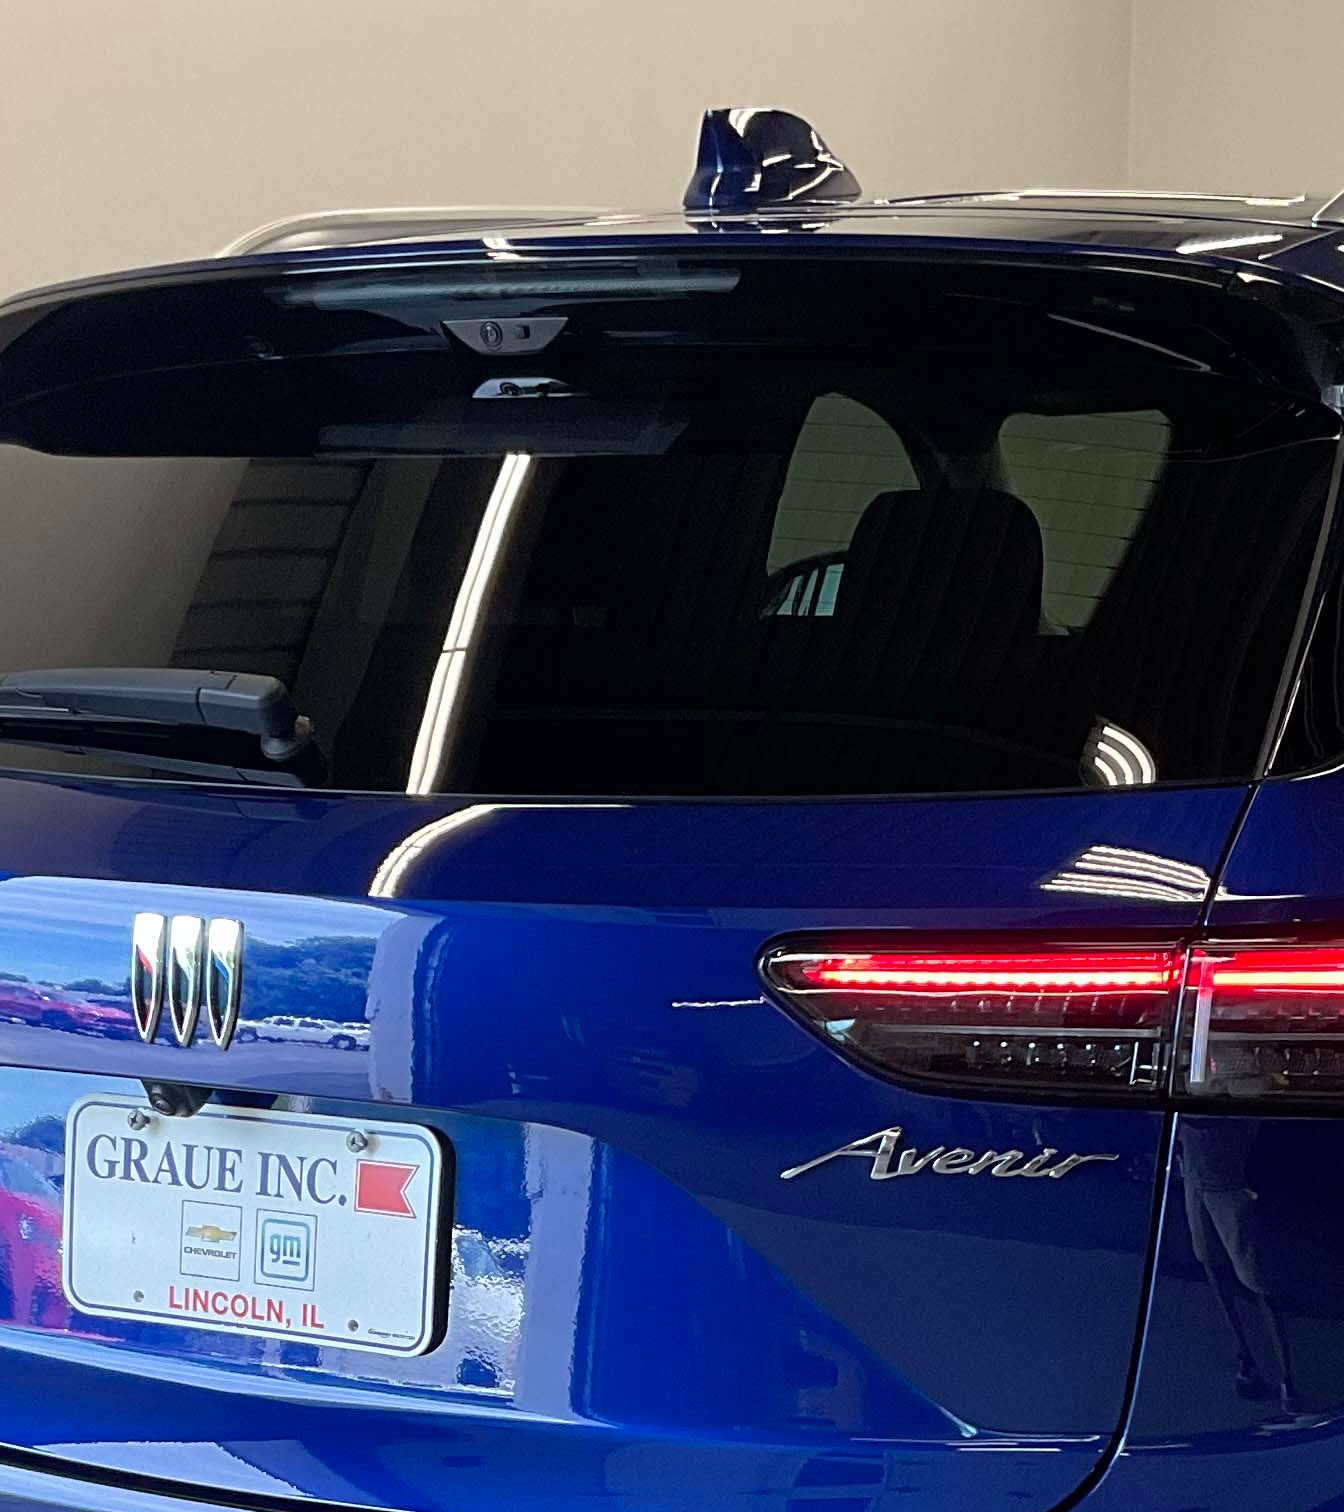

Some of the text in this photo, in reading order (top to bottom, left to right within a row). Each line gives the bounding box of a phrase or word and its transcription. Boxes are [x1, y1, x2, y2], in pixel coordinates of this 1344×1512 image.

[86, 1133, 348, 1207] GRAUE INC.
[780, 1126, 1120, 1180] Avenir
[183, 1245, 238, 1260] CHEVROLET
[169, 1285, 325, 1330] LINCOLN, IL
